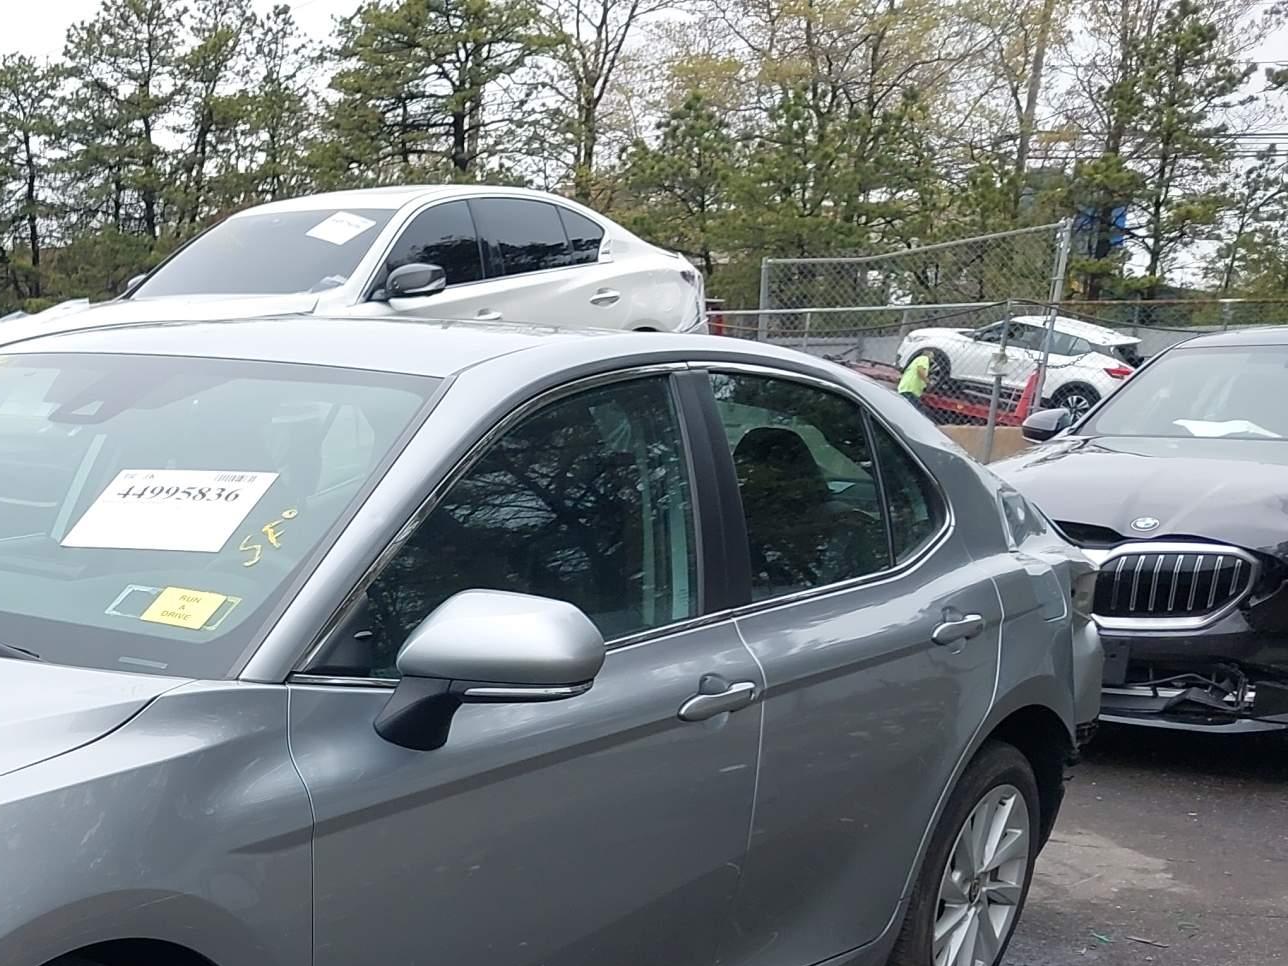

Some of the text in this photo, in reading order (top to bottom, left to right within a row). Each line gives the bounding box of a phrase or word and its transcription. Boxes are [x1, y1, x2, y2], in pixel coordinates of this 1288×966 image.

[117, 485, 242, 502] 44995836
[178, 594, 202, 604] RUN
[160, 610, 192, 621] DRIVE
